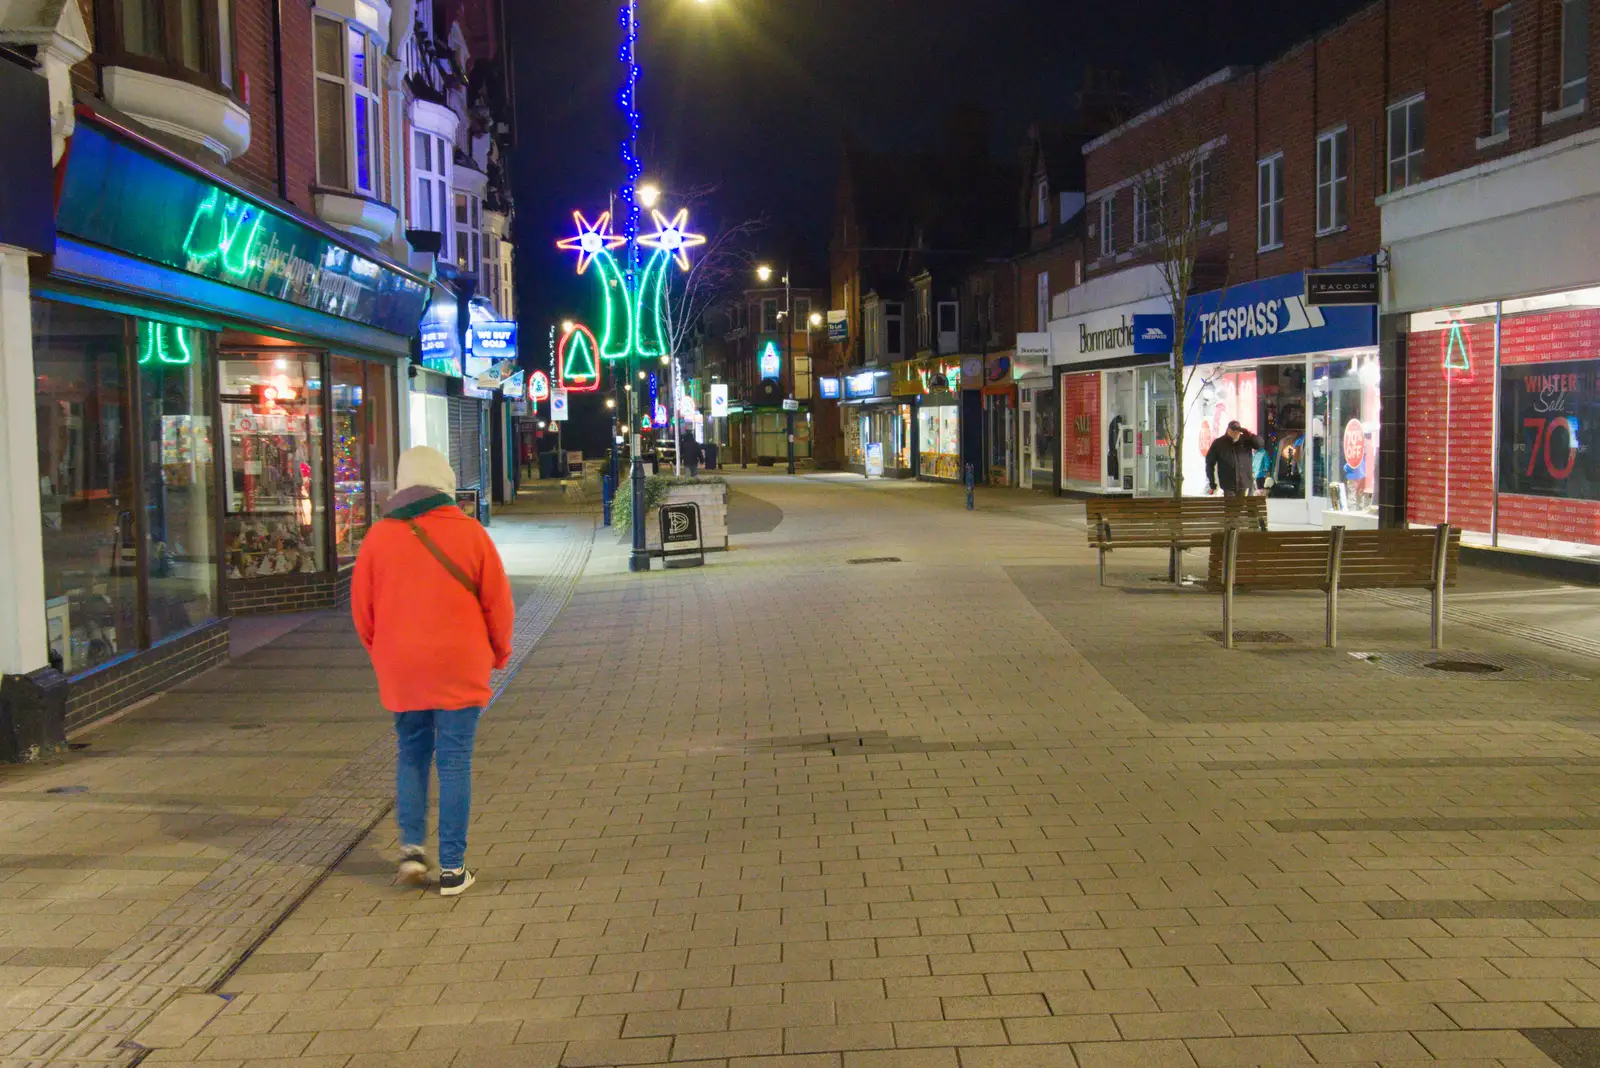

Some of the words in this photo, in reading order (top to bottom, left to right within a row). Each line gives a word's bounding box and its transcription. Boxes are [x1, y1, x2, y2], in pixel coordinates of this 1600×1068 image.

[1200, 301, 1279, 344] TRESPASS
[477, 331, 491, 339] WE
[493, 331, 511, 339] BUY
[481, 340, 507, 348] GOLD
[1523, 374, 1577, 393] WINTER
[1533, 384, 1565, 413] Sale
[1346, 430, 1363, 445] 70%
[1347, 445, 1362, 459] OFF
[1523, 416, 1577, 479] 70
